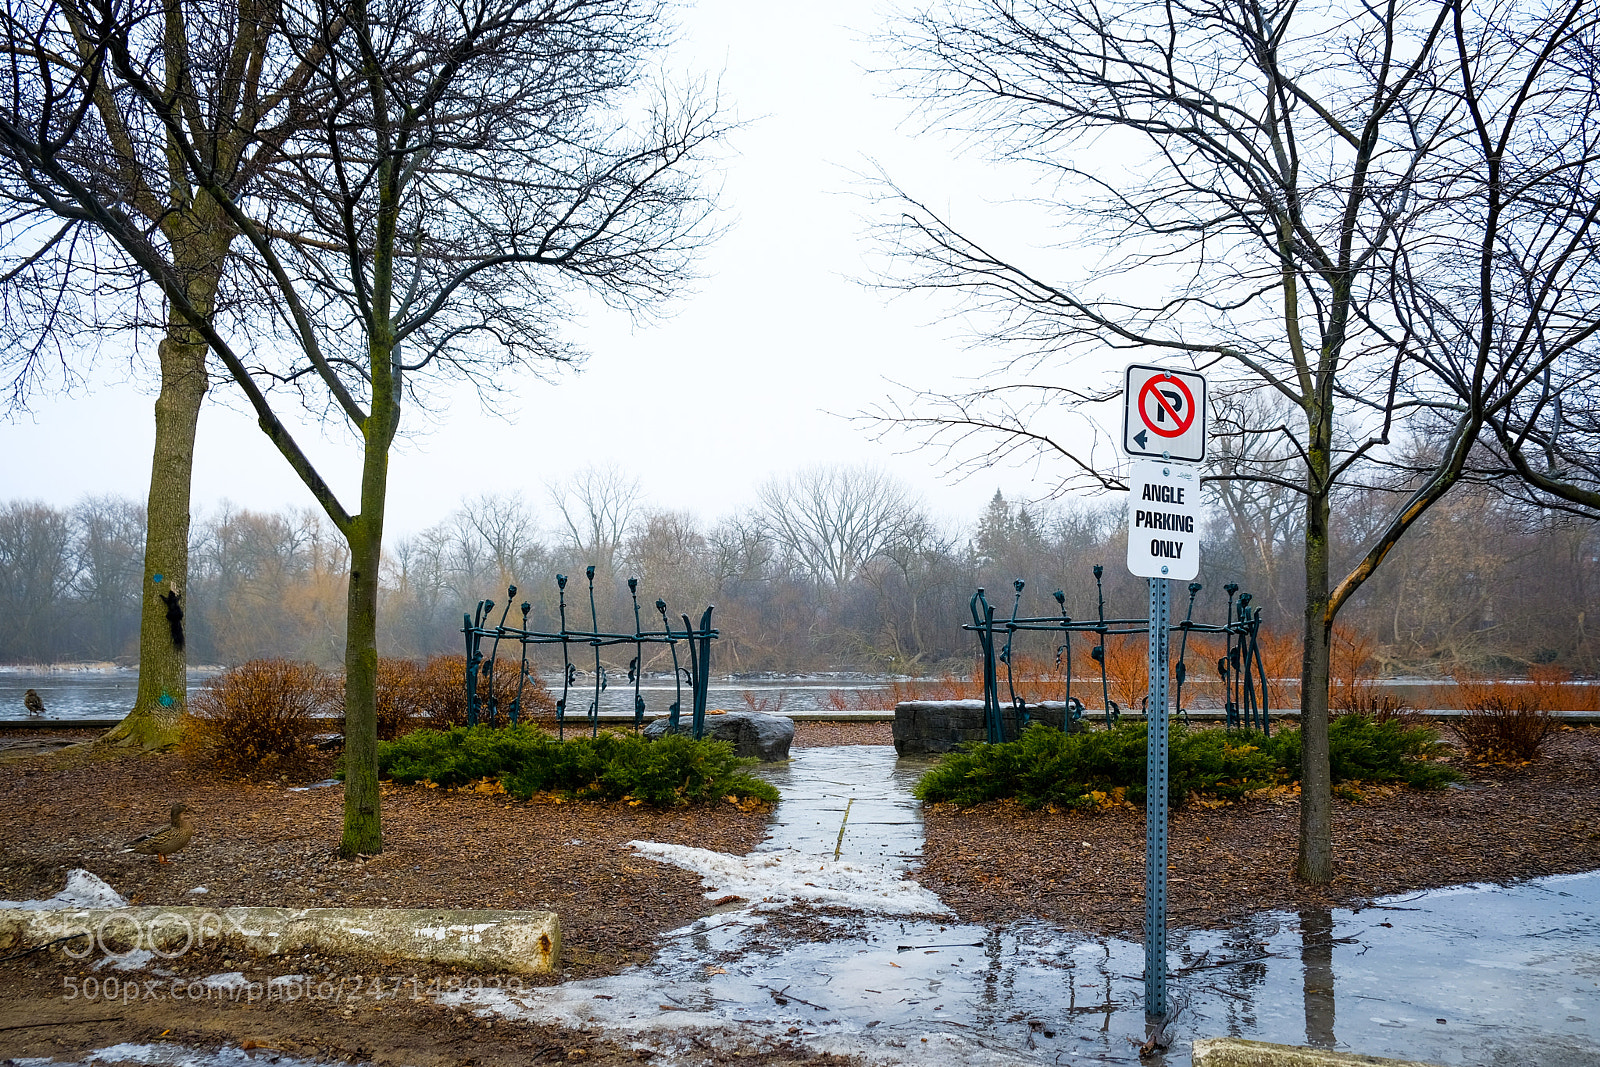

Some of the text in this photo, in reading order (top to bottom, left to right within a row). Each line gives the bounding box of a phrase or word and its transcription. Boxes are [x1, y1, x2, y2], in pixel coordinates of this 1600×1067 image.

[1142, 483, 1185, 505] ANGLE
[1135, 510, 1194, 533] PARKING
[1150, 538, 1184, 559] ONLY
